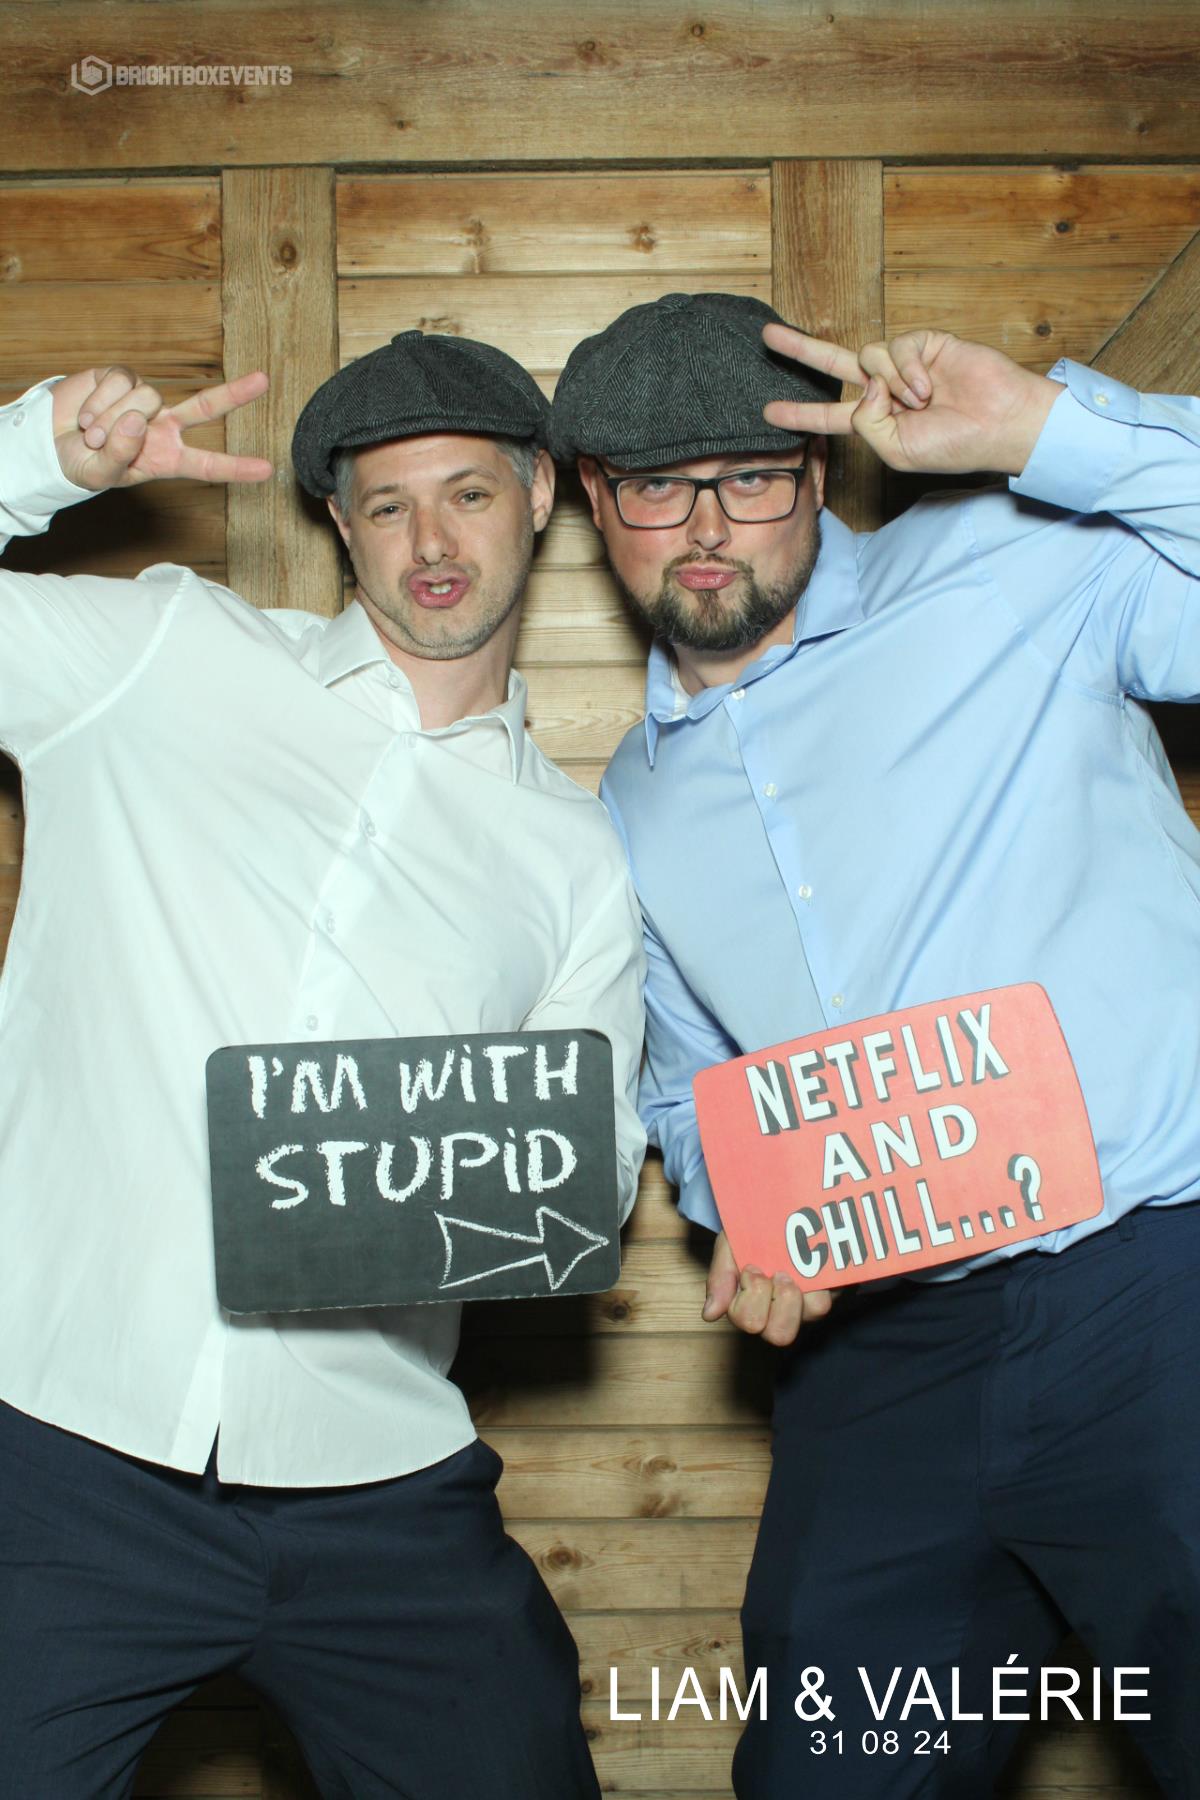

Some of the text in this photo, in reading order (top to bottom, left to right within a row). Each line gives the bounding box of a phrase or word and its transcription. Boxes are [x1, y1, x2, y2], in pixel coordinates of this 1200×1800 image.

[247, 1053, 368, 1119] I'M
[745, 1003, 1010, 1136] NETFLIX
[822, 1104, 978, 1190] AND
